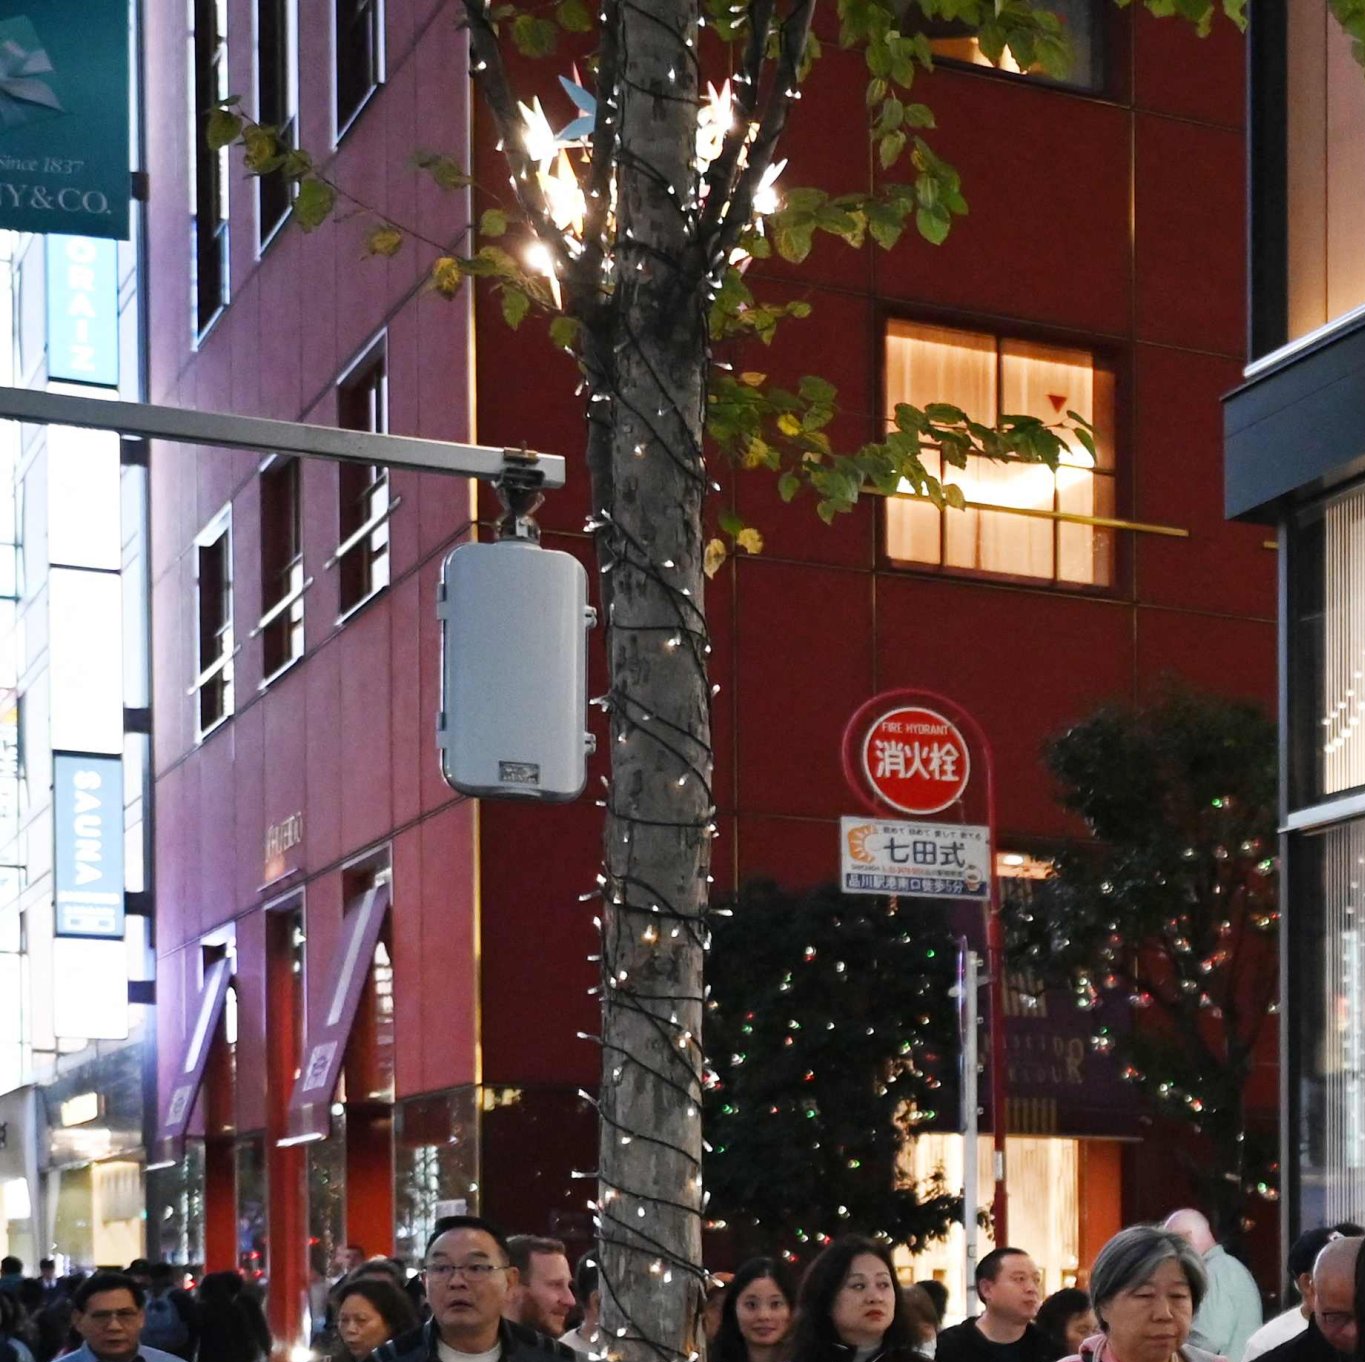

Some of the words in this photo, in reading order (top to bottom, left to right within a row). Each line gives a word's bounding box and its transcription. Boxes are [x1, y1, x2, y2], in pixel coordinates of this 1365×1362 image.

[43, 157, 84, 175] 1837
[882, 722, 902, 733] FIRE
[905, 723, 949, 735] HYDRANT
[875, 739, 960, 782] 消火栓
[72, 770, 104, 886] SAUNA
[883, 837, 966, 868] 七田式
